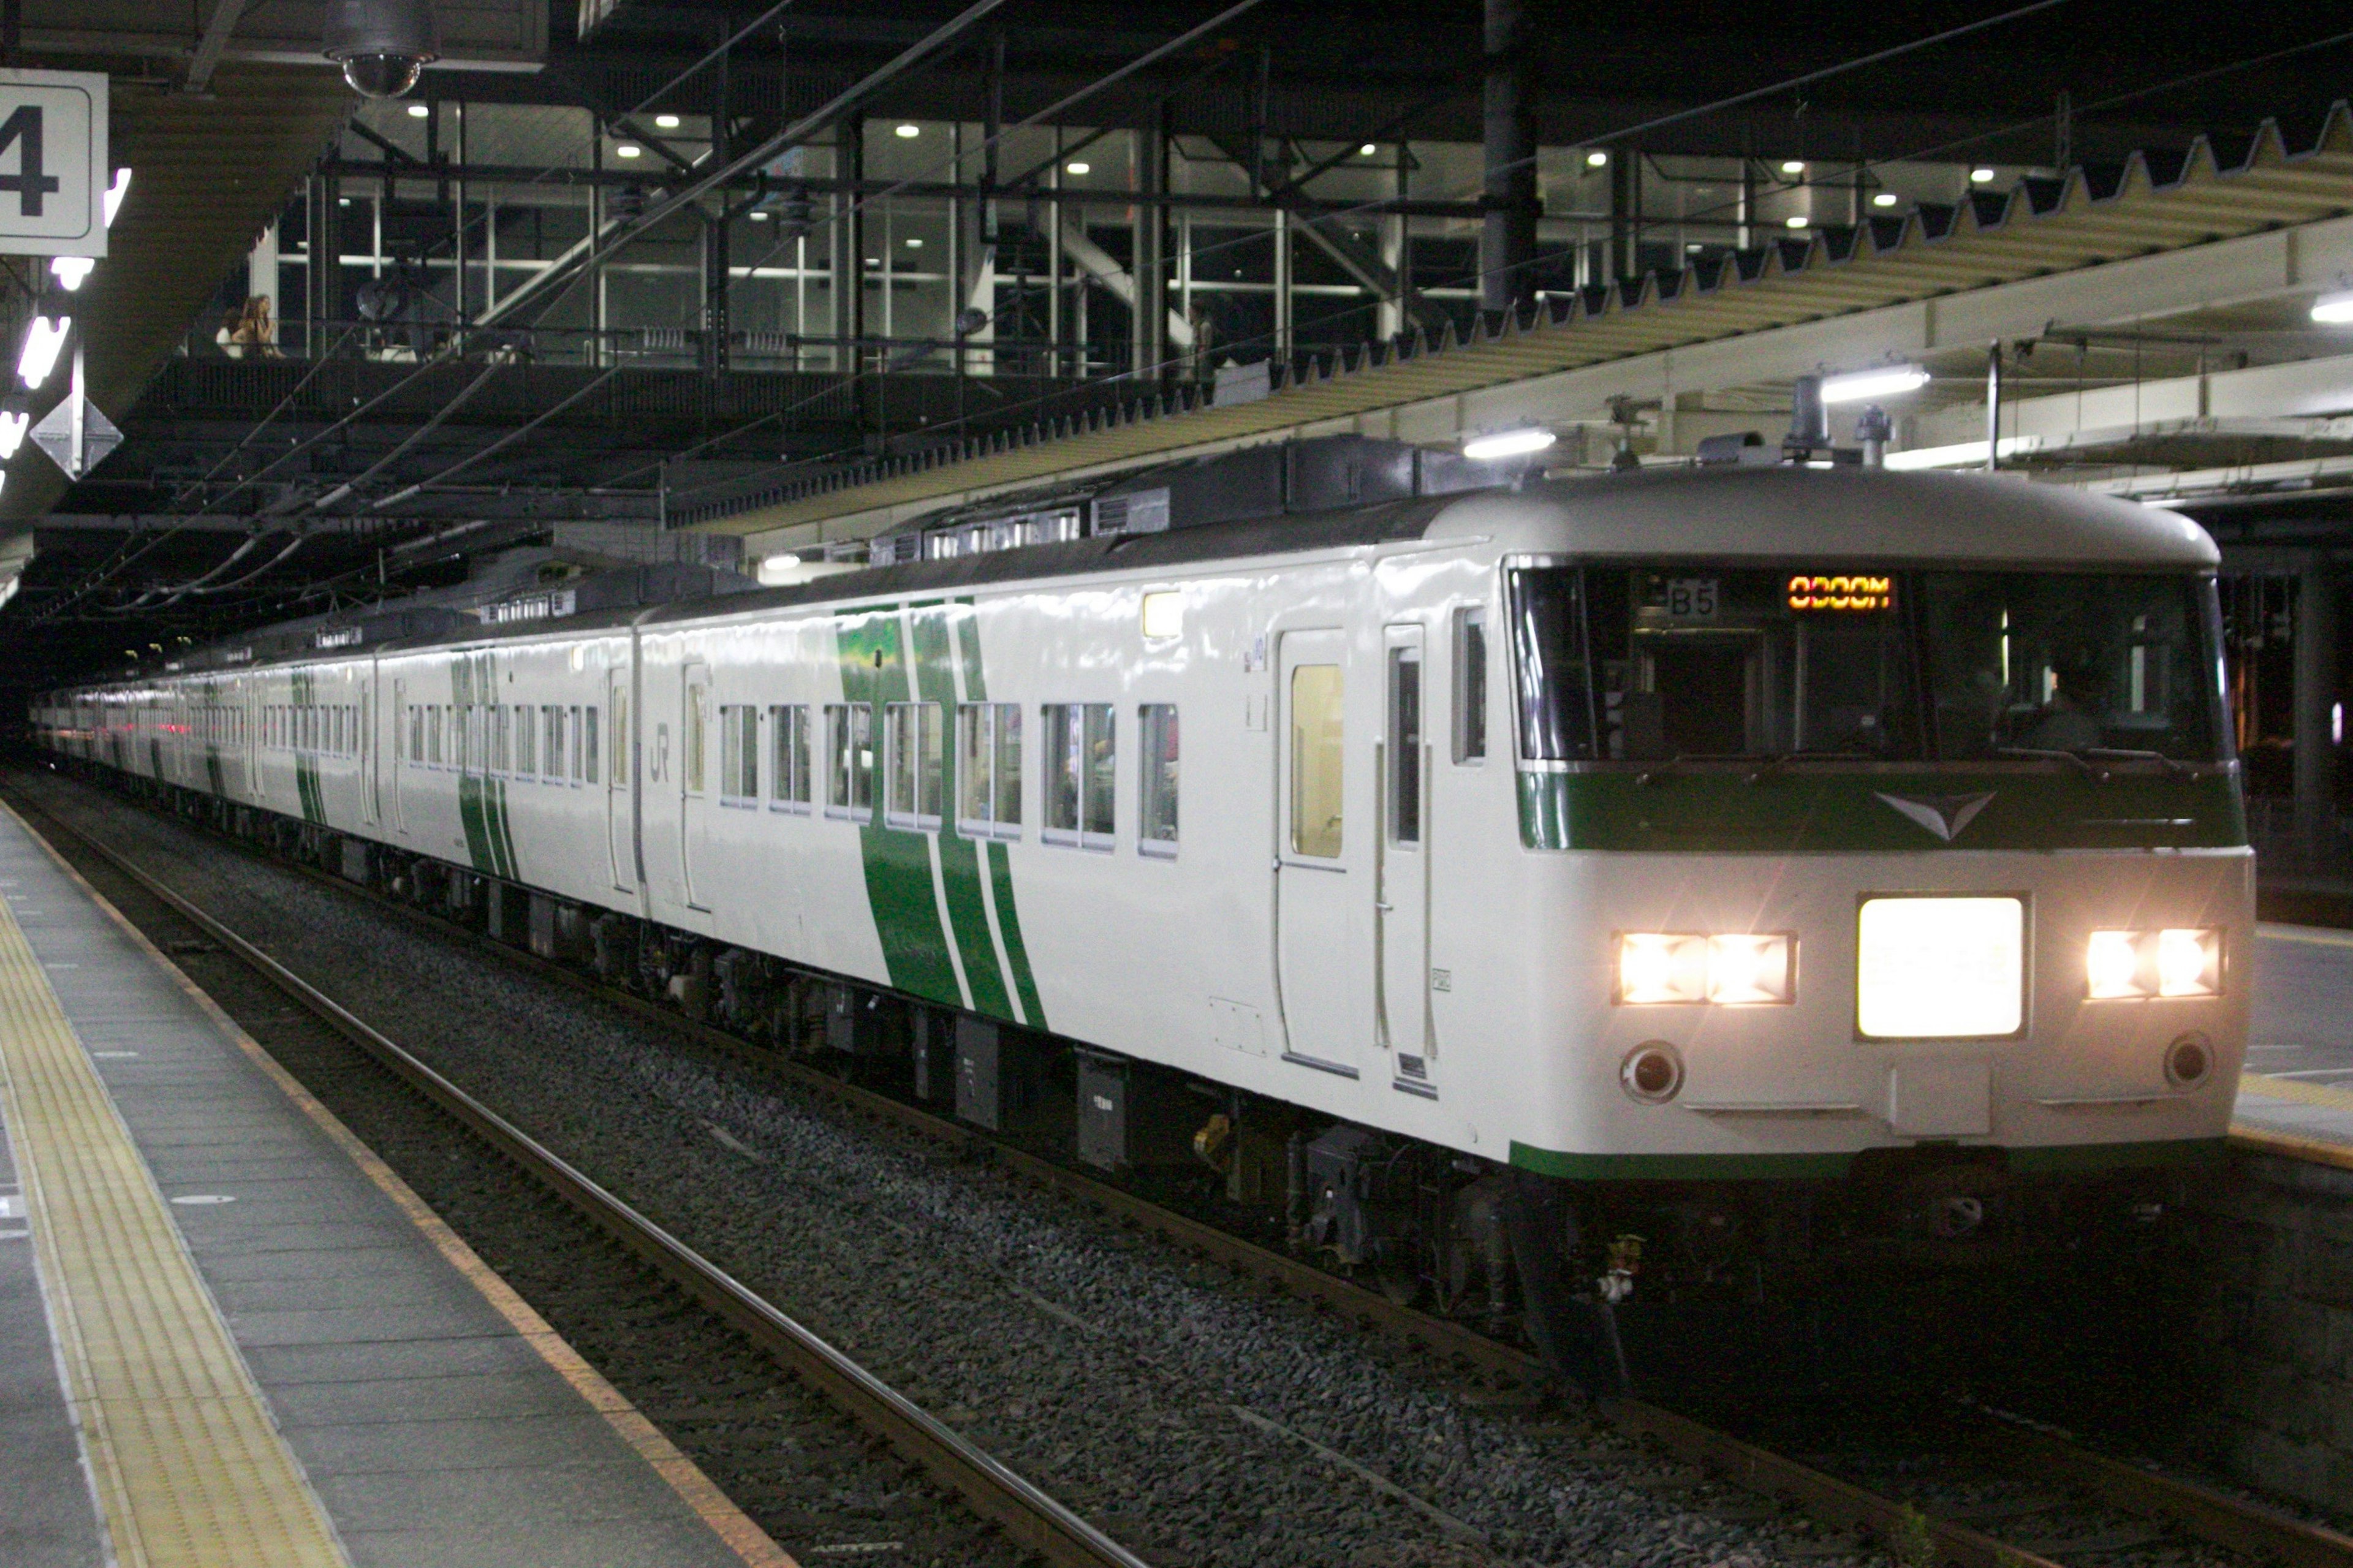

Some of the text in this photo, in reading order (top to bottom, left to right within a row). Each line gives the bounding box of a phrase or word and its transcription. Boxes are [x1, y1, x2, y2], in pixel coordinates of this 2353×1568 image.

[0, 105, 59, 216] 4
[1672, 586, 1713, 615] B5
[650, 722, 669, 782] JR
